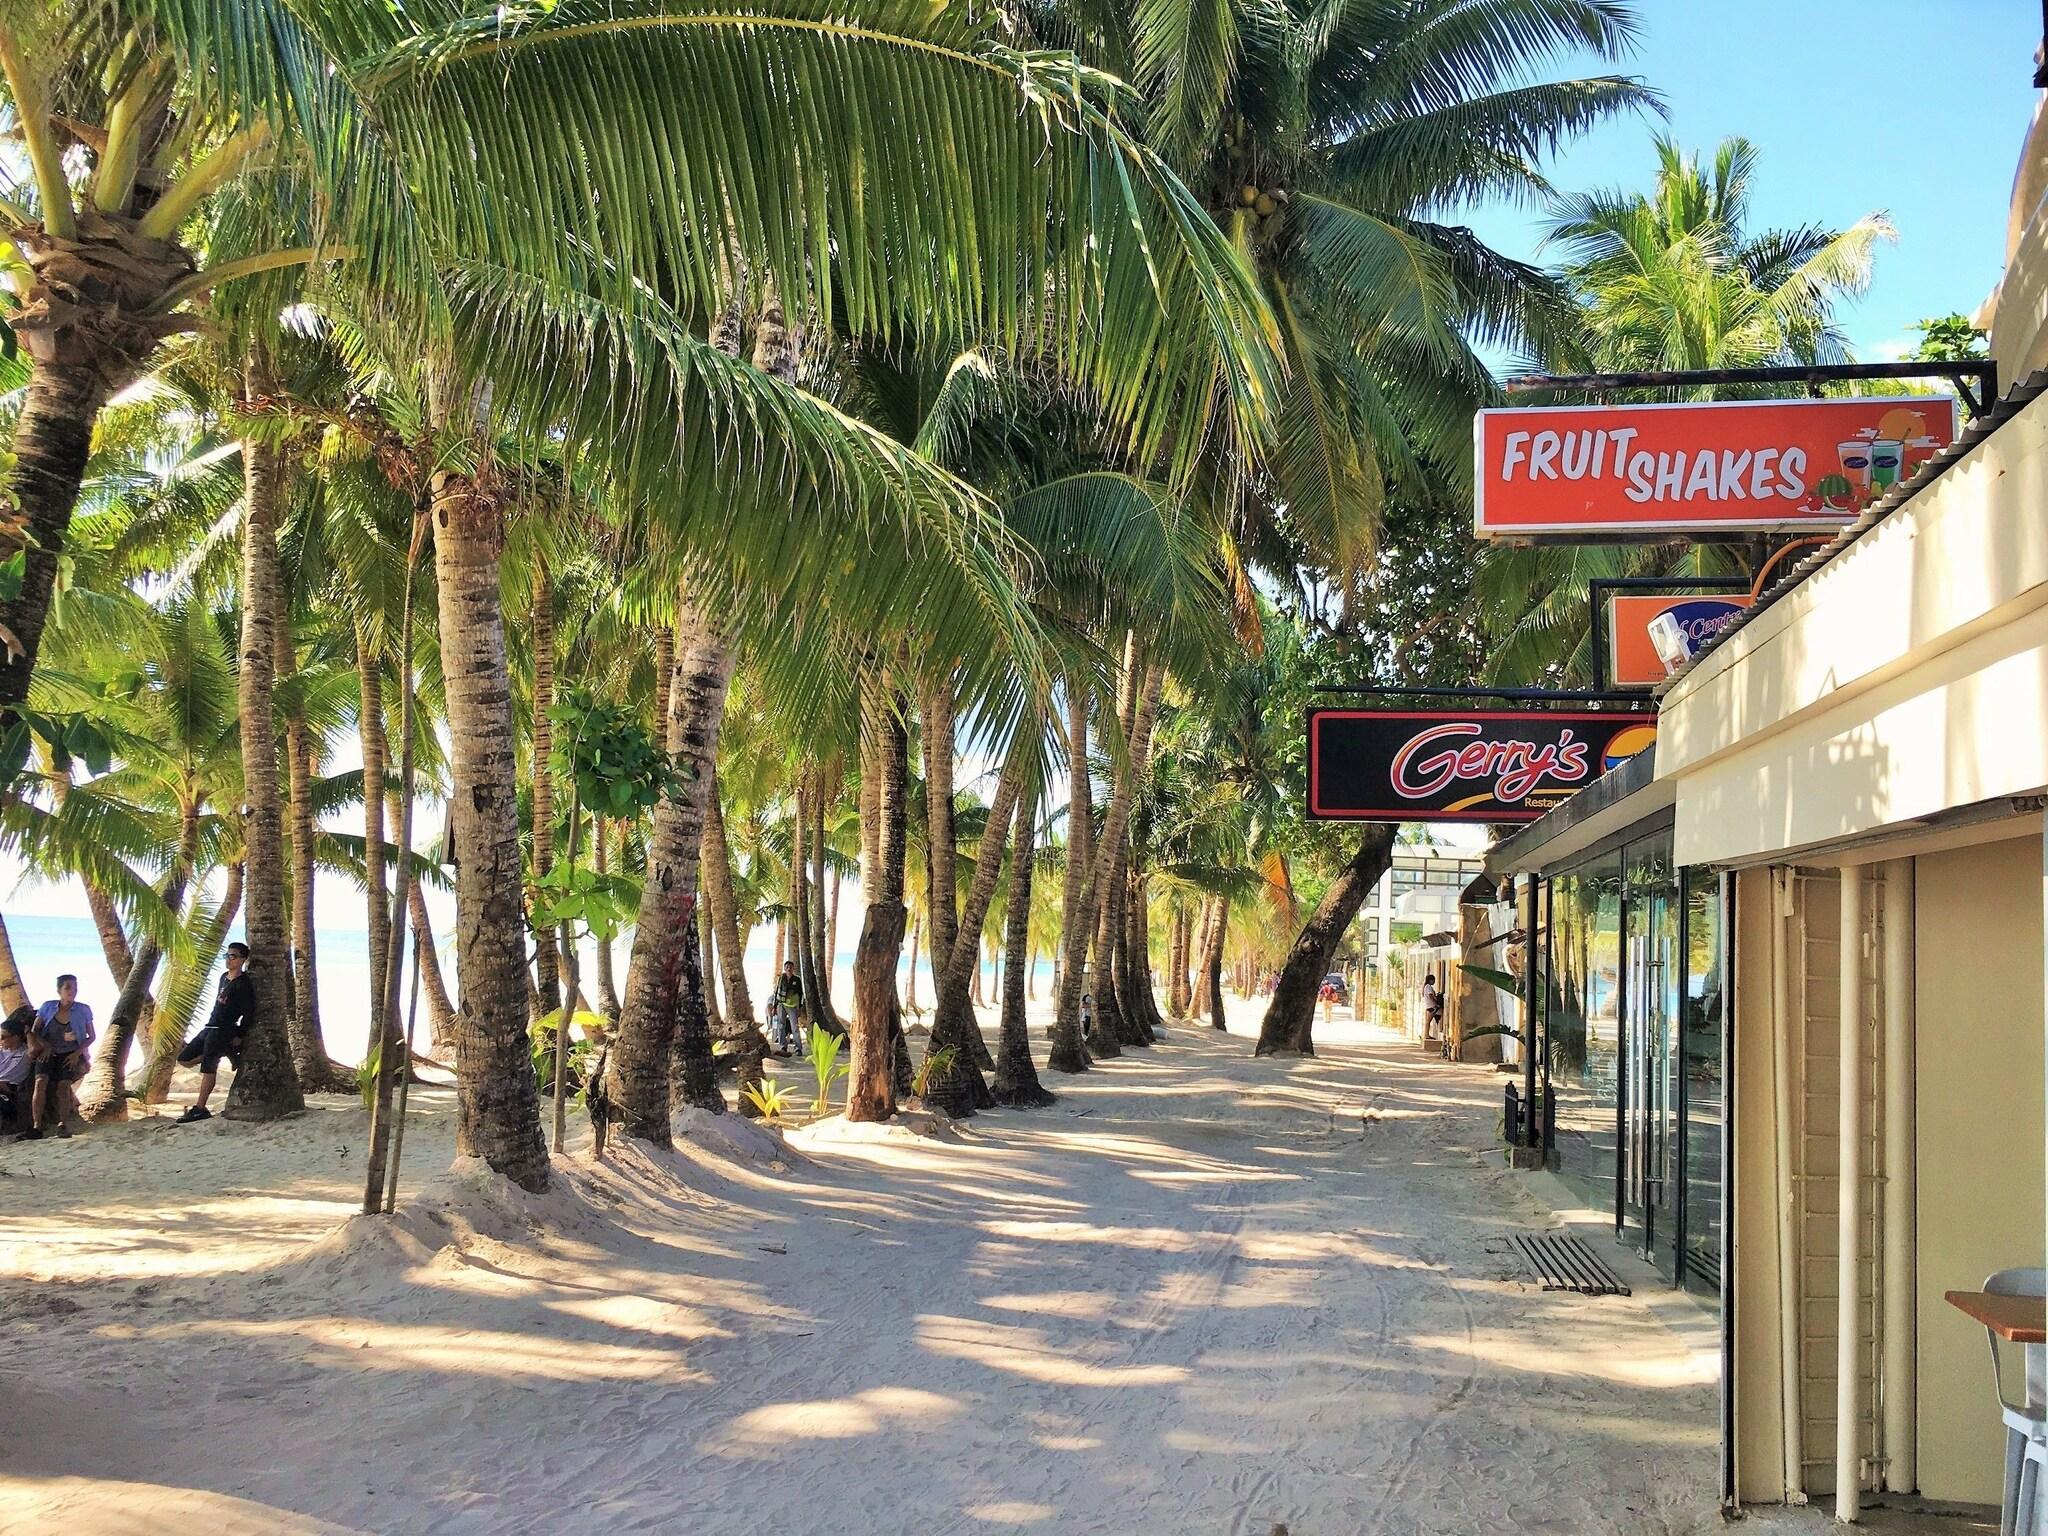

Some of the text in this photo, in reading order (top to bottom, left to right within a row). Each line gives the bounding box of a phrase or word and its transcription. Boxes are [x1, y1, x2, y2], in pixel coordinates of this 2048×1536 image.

[1502, 427, 1806, 502] FRUIT SHAKES
[1391, 723, 1588, 801] Gerry's
